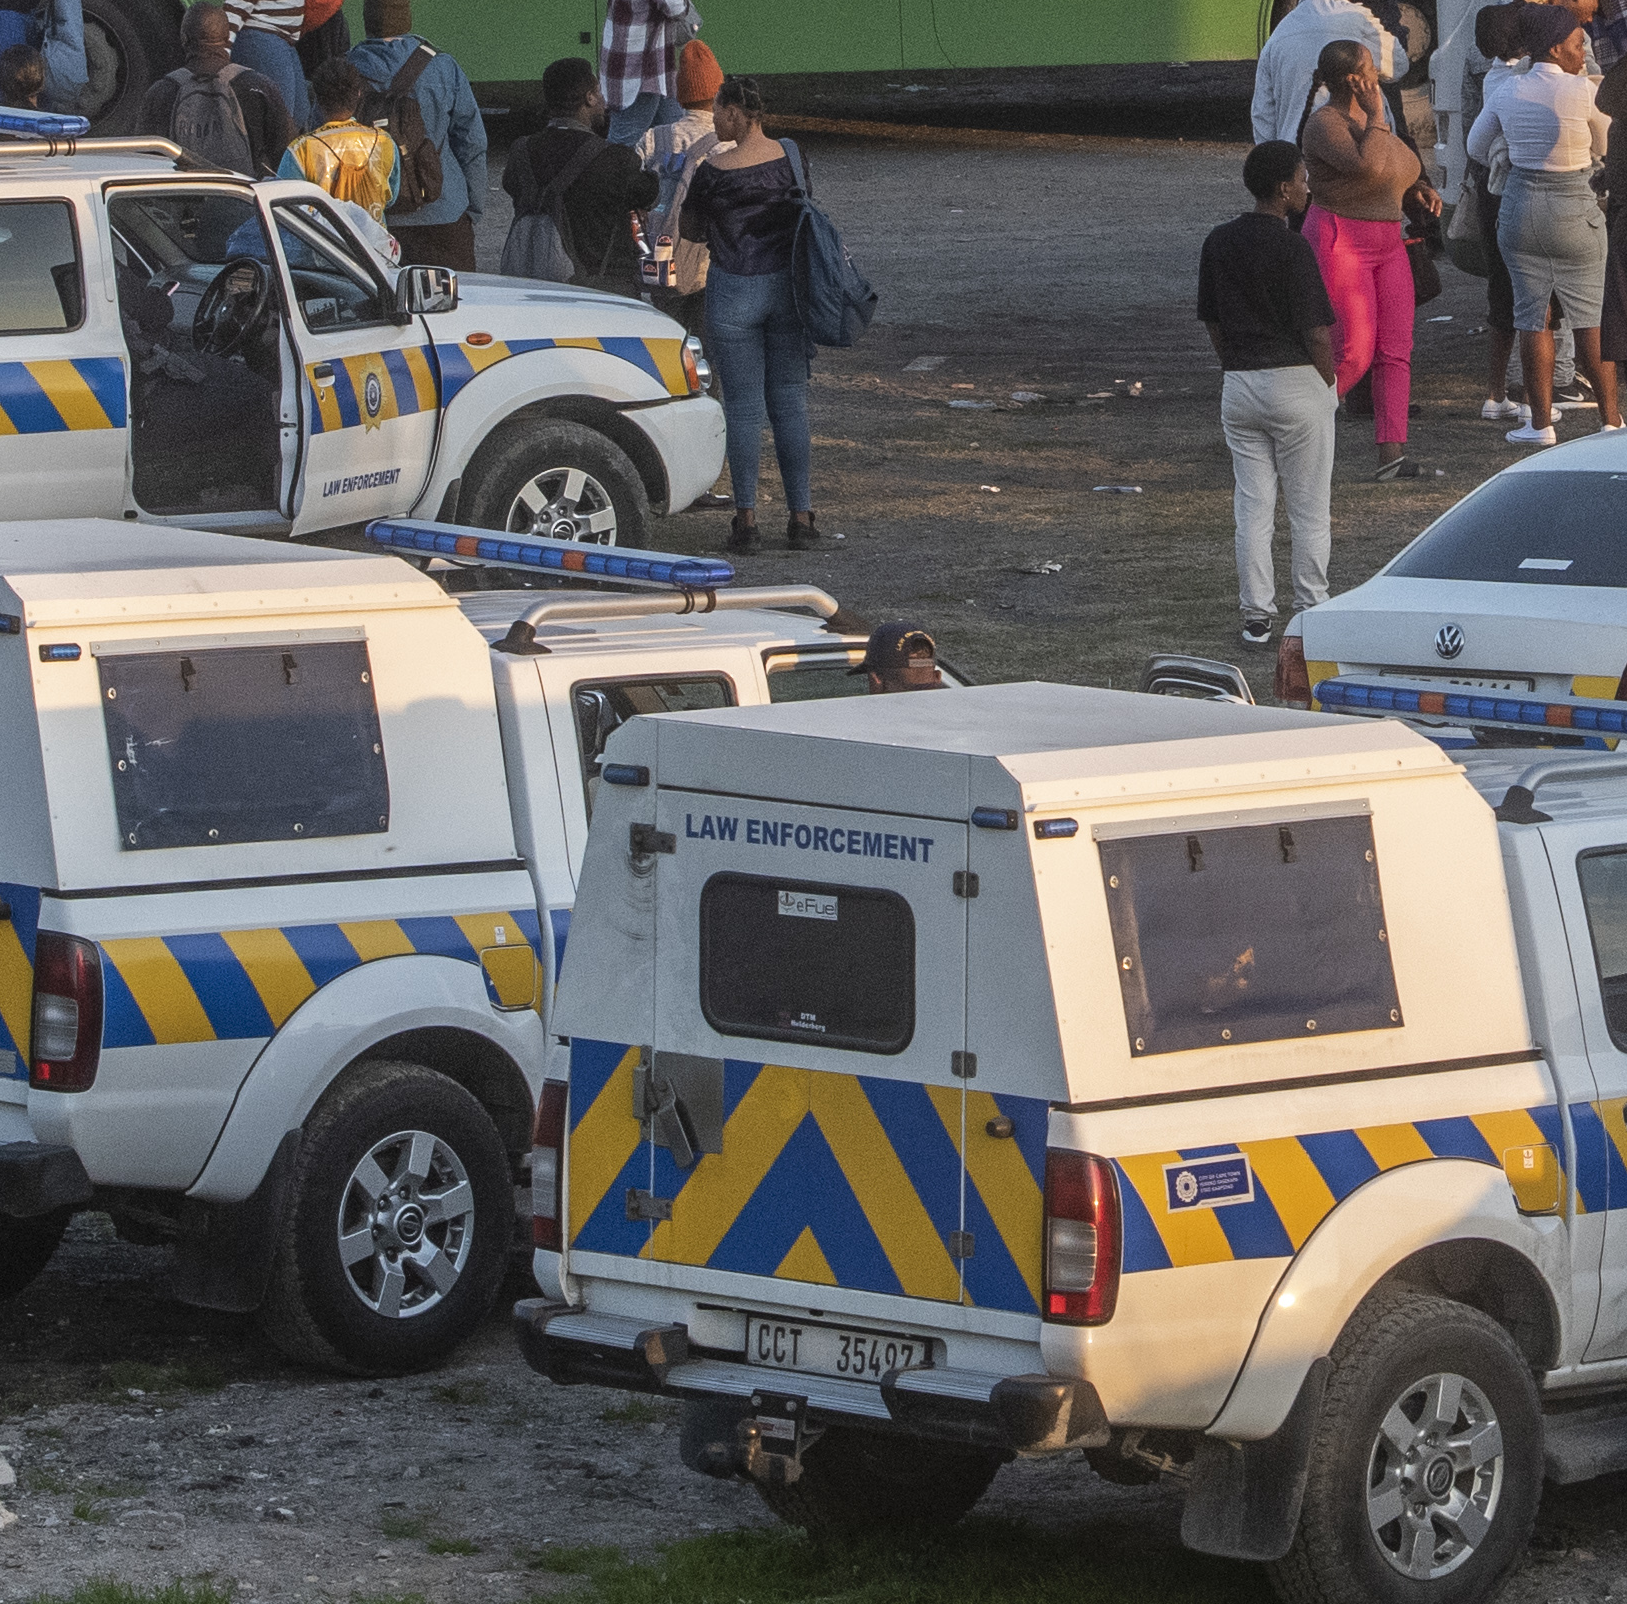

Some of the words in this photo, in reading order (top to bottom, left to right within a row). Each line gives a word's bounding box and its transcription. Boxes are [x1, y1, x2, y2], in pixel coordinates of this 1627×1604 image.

[322, 479, 340, 498] LAW
[342, 468, 402, 494] ENFORCEMENT
[684, 812, 738, 842] LAW
[745, 819, 934, 863] ENFORCEMENT
[758, 1324, 803, 1365] CCT
